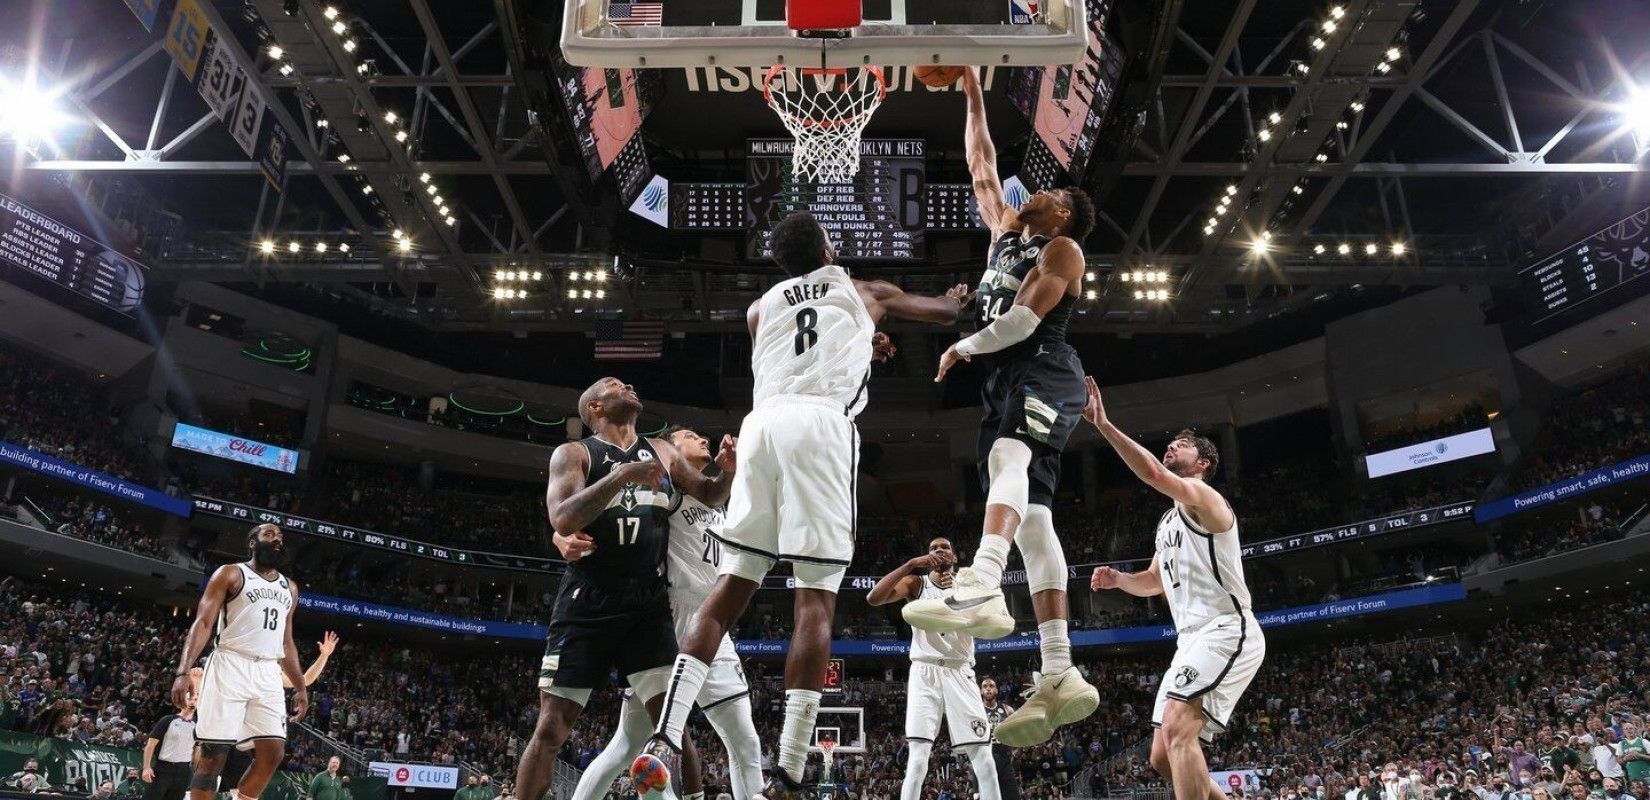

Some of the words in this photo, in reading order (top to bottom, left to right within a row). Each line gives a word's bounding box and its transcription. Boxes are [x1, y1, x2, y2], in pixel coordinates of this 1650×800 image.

[1014, 15, 1029, 23] NBA
[171, 12, 200, 59] 15
[210, 59, 230, 101] 31
[242, 102, 257, 135] 3
[897, 141, 922, 155] NETS
[0, 198, 80, 244] LEADERBOARD
[16, 220, 30, 230] PTS
[32, 228, 60, 245] LEADER
[3, 233, 34, 251] ASSISTS
[36, 248, 64, 265] LEADER
[13, 228, 29, 238] RBS
[30, 235, 58, 254] LEADER
[0, 241, 31, 261] BLOCKS
[32, 255, 60, 272] LEADER
[1582, 264, 1594, 273] 10
[29, 262, 57, 280] LEADER
[1586, 273, 1596, 282] 13
[784, 283, 829, 306] GREEN
[982, 295, 1004, 321] 34
[794, 308, 818, 356] 8
[186, 430, 213, 441] MADE
[228, 438, 267, 456] Chill
[1409, 451, 1432, 460] Johnson
[0, 447, 39, 468] building
[41, 461, 76, 478] partner
[90, 475, 116, 490] Fiserv
[118, 484, 144, 499] Forum
[1414, 456, 1438, 464] Controls
[1514, 491, 1555, 508] Powering
[1556, 482, 1586, 496] smart,
[1588, 473, 1611, 487] safe,
[1612, 462, 1650, 479] healthy
[233, 508, 248, 517] FG
[260, 513, 280, 523] 47%
[287, 518, 307, 528] 3PT
[318, 525, 335, 535] 21%
[342, 530, 356, 539] FT
[365, 534, 385, 546] 80%
[390, 540, 408, 550] FLS
[417, 545, 424, 554] 2
[432, 549, 448, 559] TOL
[617, 517, 640, 545] 17
[1242, 548, 1254, 556] PT
[1264, 542, 1283, 552] 33%
[1289, 538, 1301, 547] FT
[1313, 533, 1333, 543] 57%
[1338, 527, 1357, 538] FLS
[1388, 518, 1408, 527] TOL
[702, 533, 721, 568] 20
[852, 578, 876, 588] 4th
[263, 607, 278, 630] 13
[314, 600, 340, 611] smart,
[342, 604, 361, 614] safe,
[364, 606, 392, 620] healthy
[394, 610, 408, 620] and
[410, 615, 450, 628] sustainable
[452, 621, 486, 633] buildings
[1287, 610, 1316, 622] partner
[1320, 607, 1328, 615] of
[1330, 603, 1356, 614] Fiserv
[1358, 600, 1386, 610] Forum
[872, 644, 905, 652] Powering
[992, 639, 1034, 649] sustainable
[418, 770, 450, 783] CLUB
